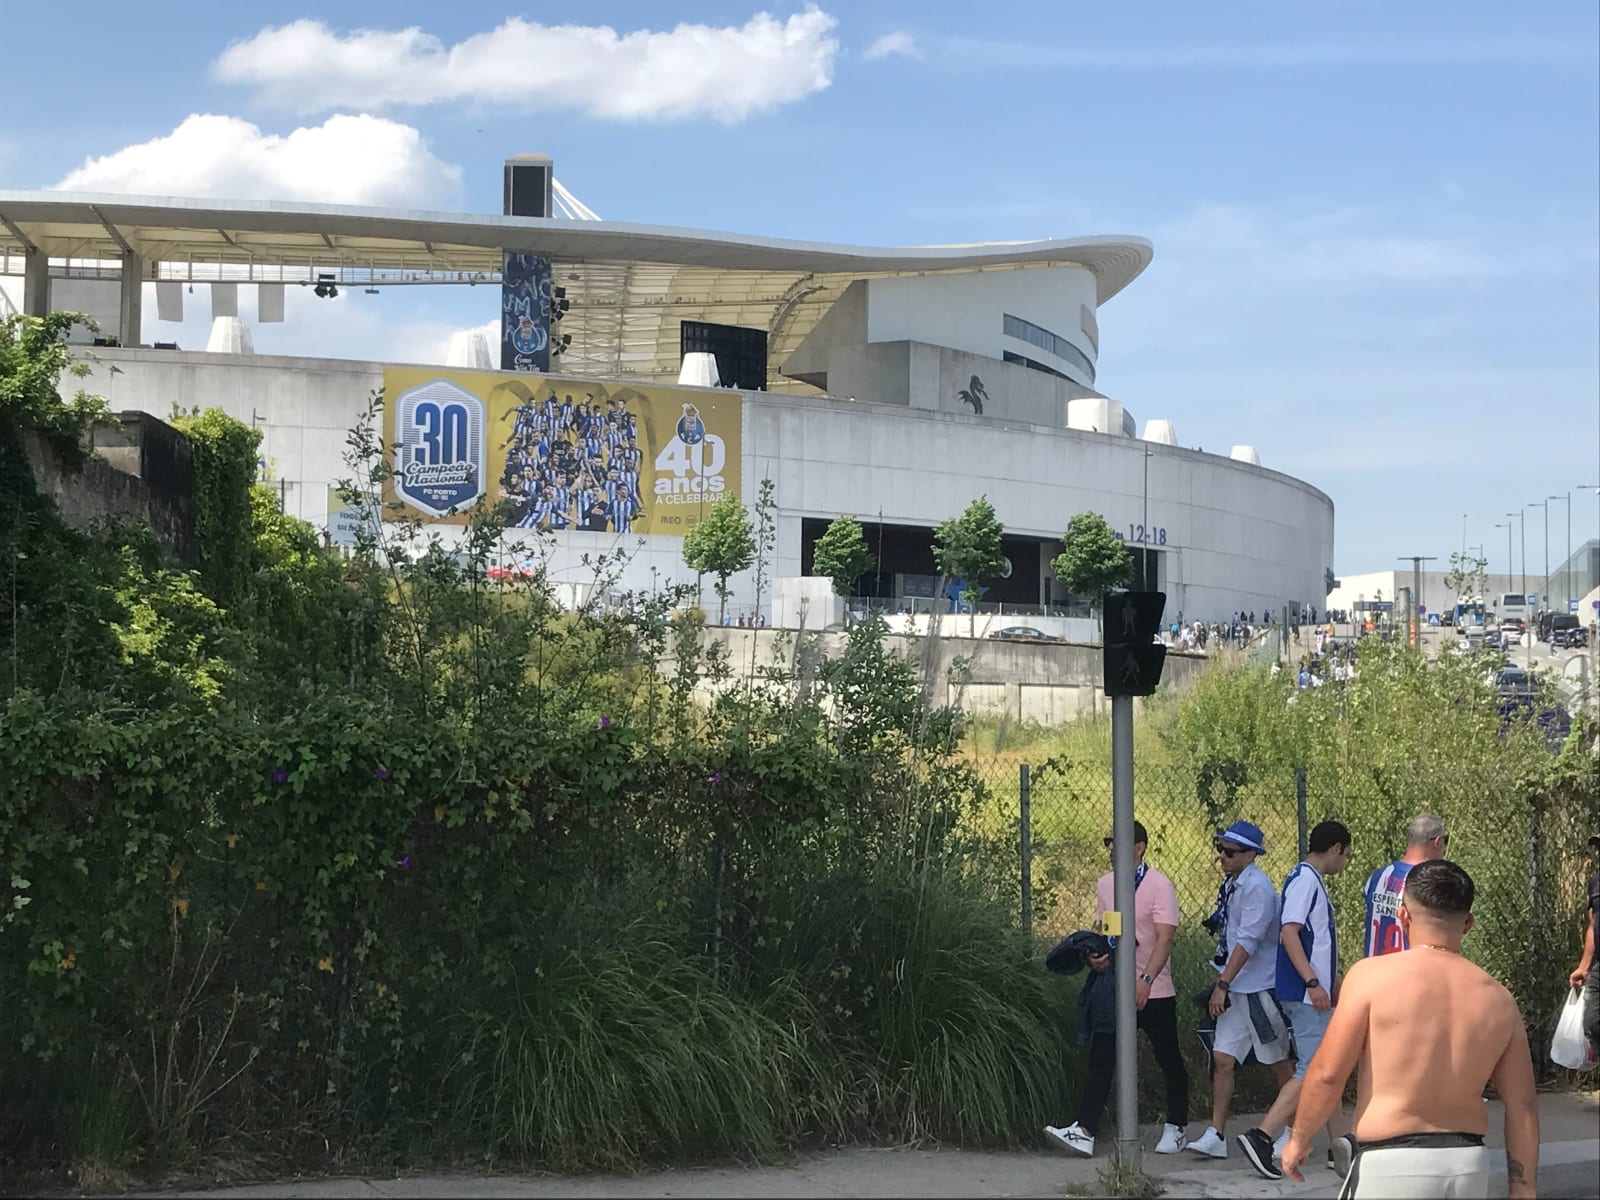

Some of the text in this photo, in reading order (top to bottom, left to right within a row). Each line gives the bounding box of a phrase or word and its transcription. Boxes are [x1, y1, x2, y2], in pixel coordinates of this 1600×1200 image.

[415, 402, 467, 465] 30
[655, 434, 725, 477] 40
[406, 461, 474, 478] Campeão
[407, 473, 469, 485] Naciona
[654, 477, 725, 494] anos
[656, 495, 663, 504] A
[1129, 524, 1166, 545] 12-18
